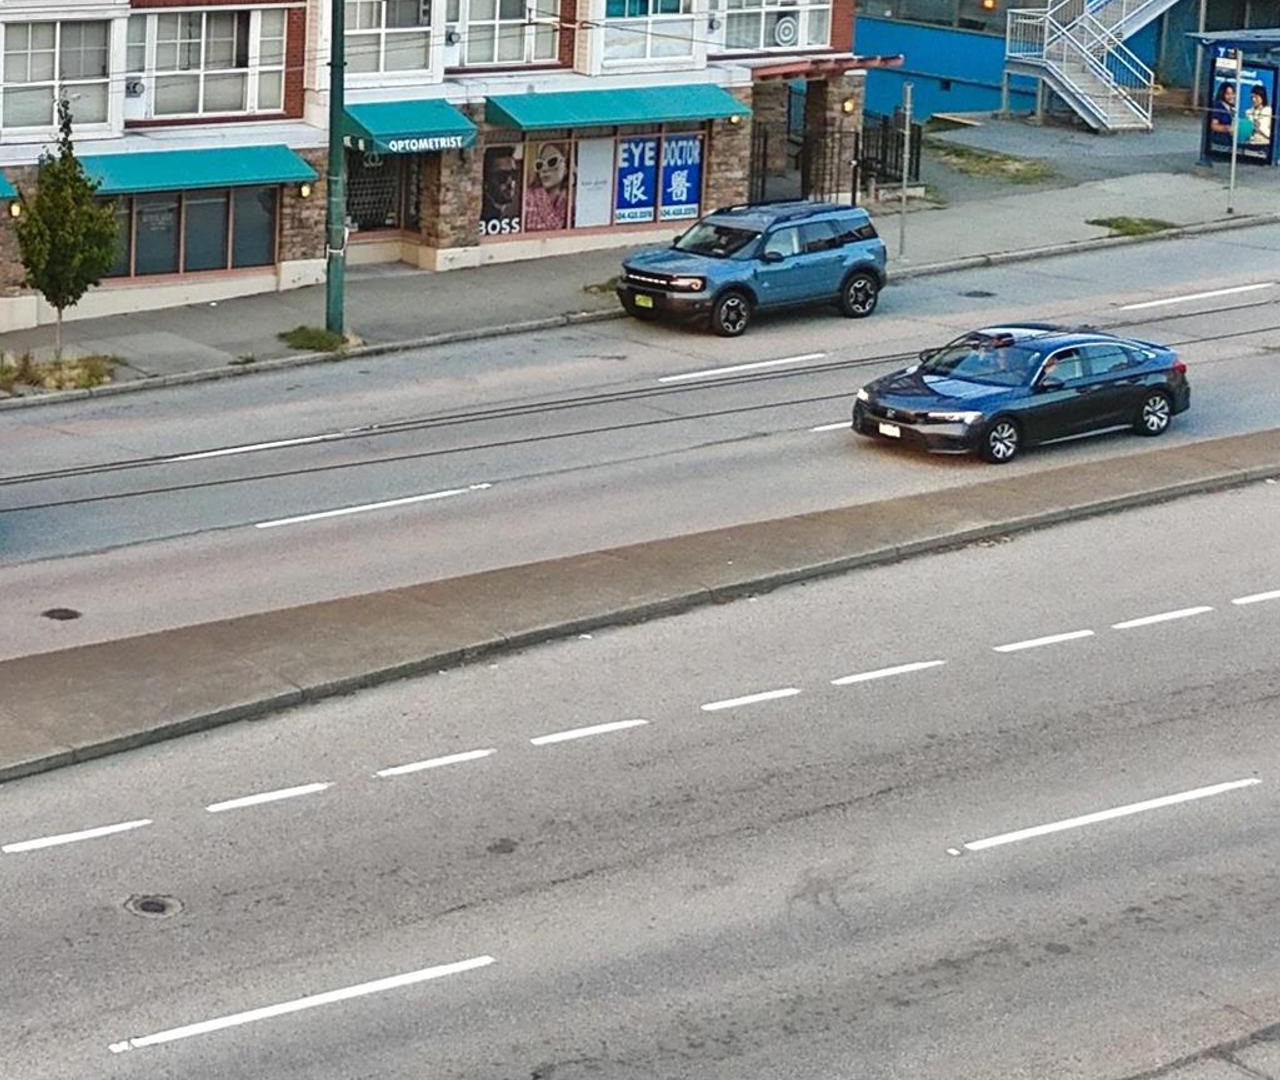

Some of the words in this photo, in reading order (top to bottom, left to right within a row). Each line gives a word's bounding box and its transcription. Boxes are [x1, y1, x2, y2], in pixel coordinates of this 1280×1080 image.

[389, 136, 462, 152] OPTOMETRIST
[618, 142, 656, 168] EYE
[663, 139, 700, 167] DOCTOR
